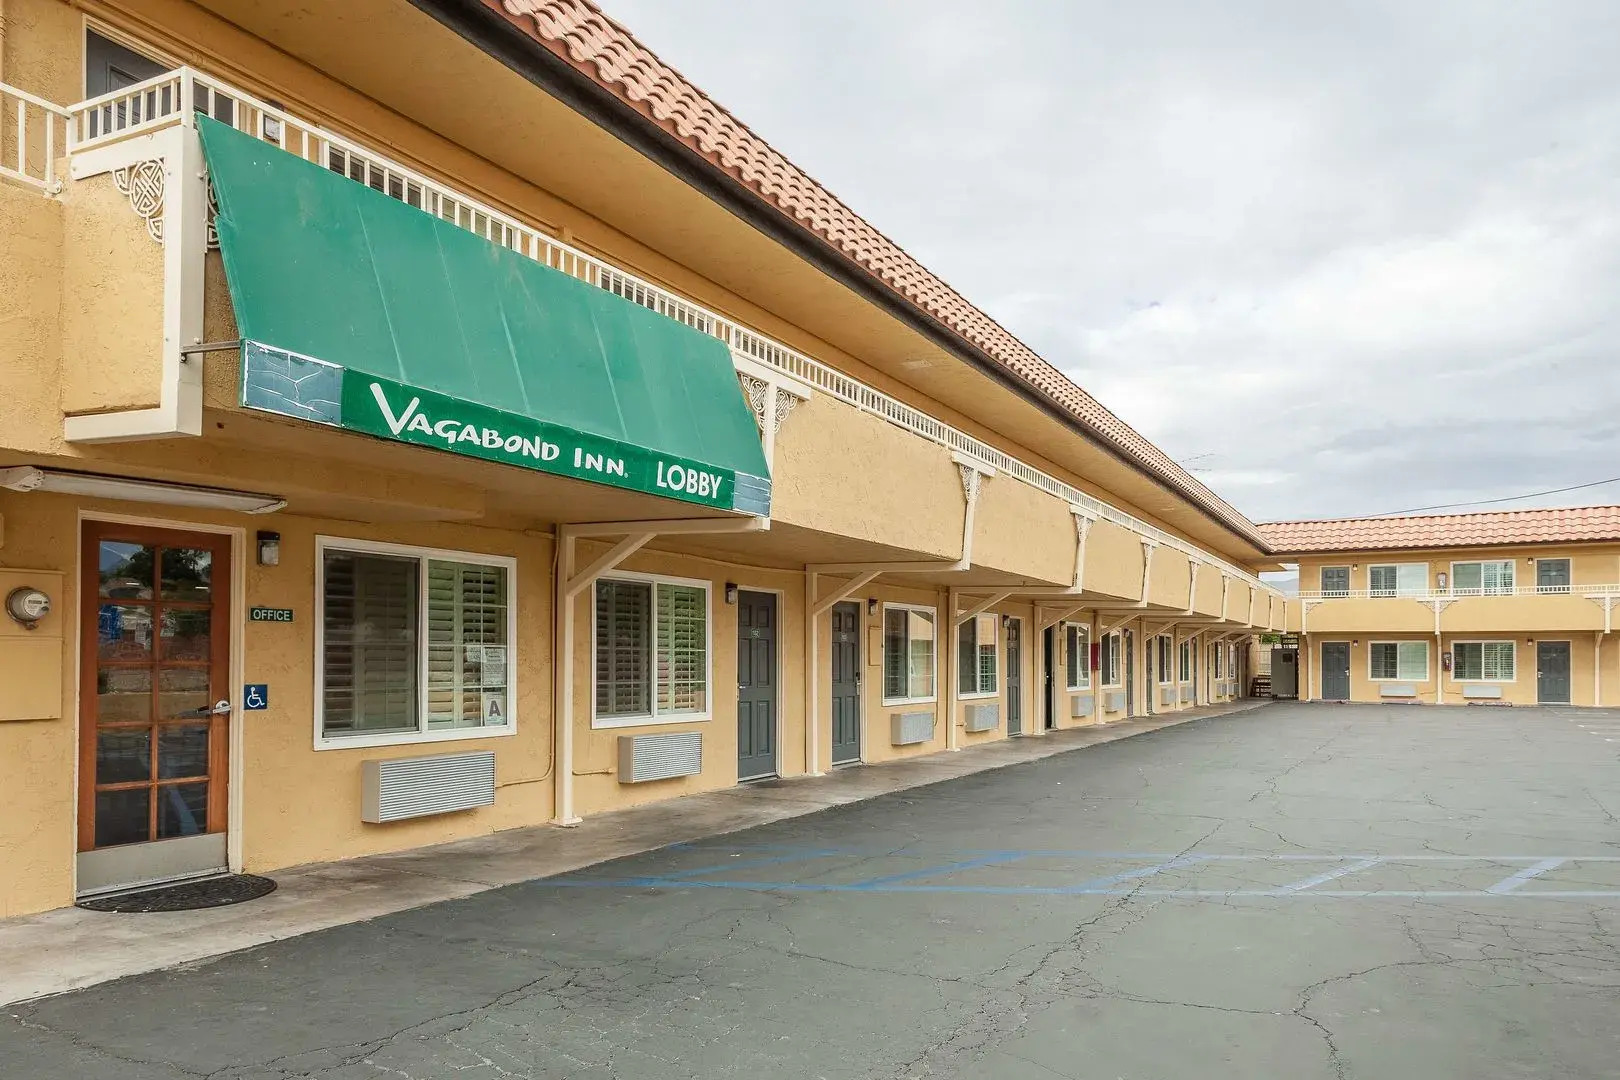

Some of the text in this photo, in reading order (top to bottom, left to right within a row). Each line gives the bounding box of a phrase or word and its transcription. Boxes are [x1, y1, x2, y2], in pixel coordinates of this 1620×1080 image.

[369, 382, 560, 461] VAGABOND
[656, 460, 723, 499] LOBBY
[253, 609, 291, 621] OFFICE
[488, 700, 502, 717] A
